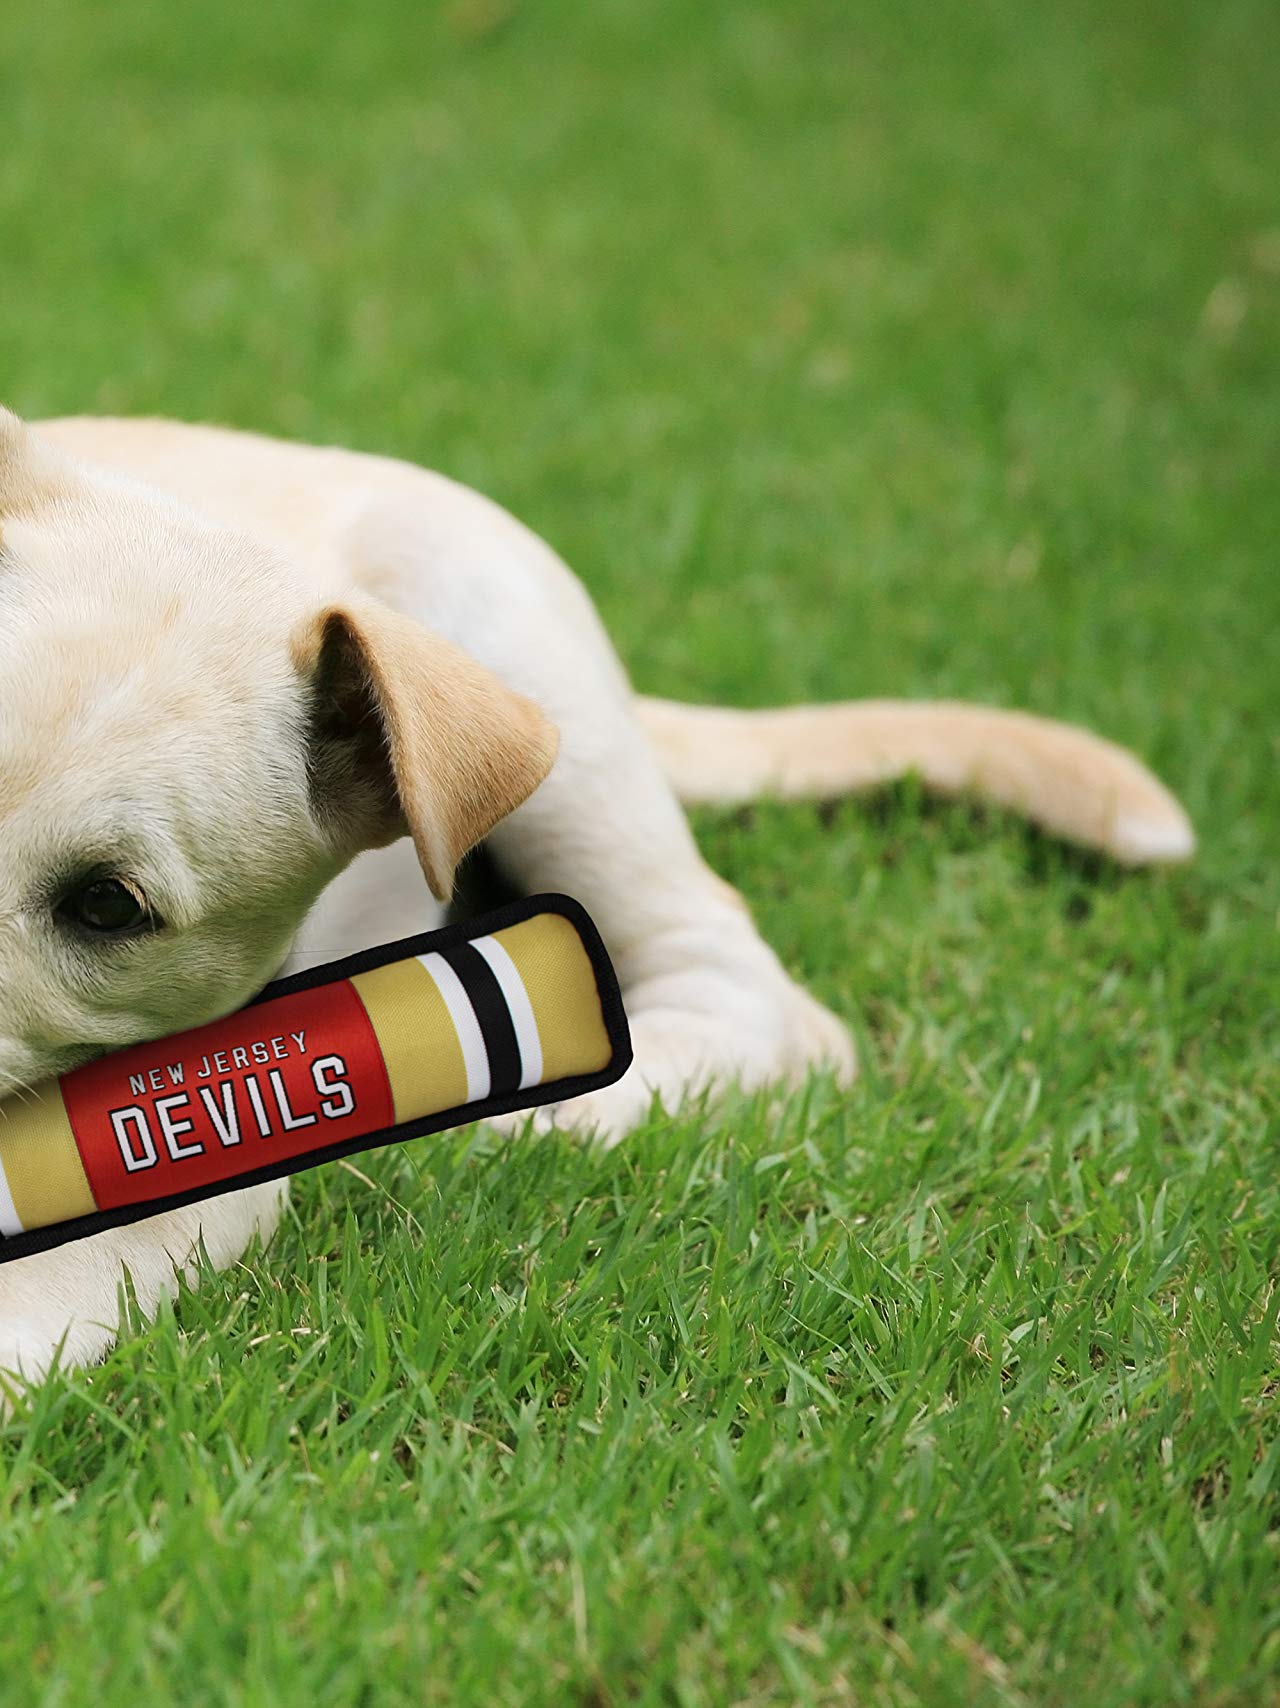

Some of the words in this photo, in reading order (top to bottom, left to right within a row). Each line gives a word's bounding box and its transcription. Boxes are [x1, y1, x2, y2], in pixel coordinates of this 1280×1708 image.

[128, 1061, 184, 1097] NEW
[196, 1030, 307, 1079] JERSEY
[108, 1053, 357, 1174] DEVILS
